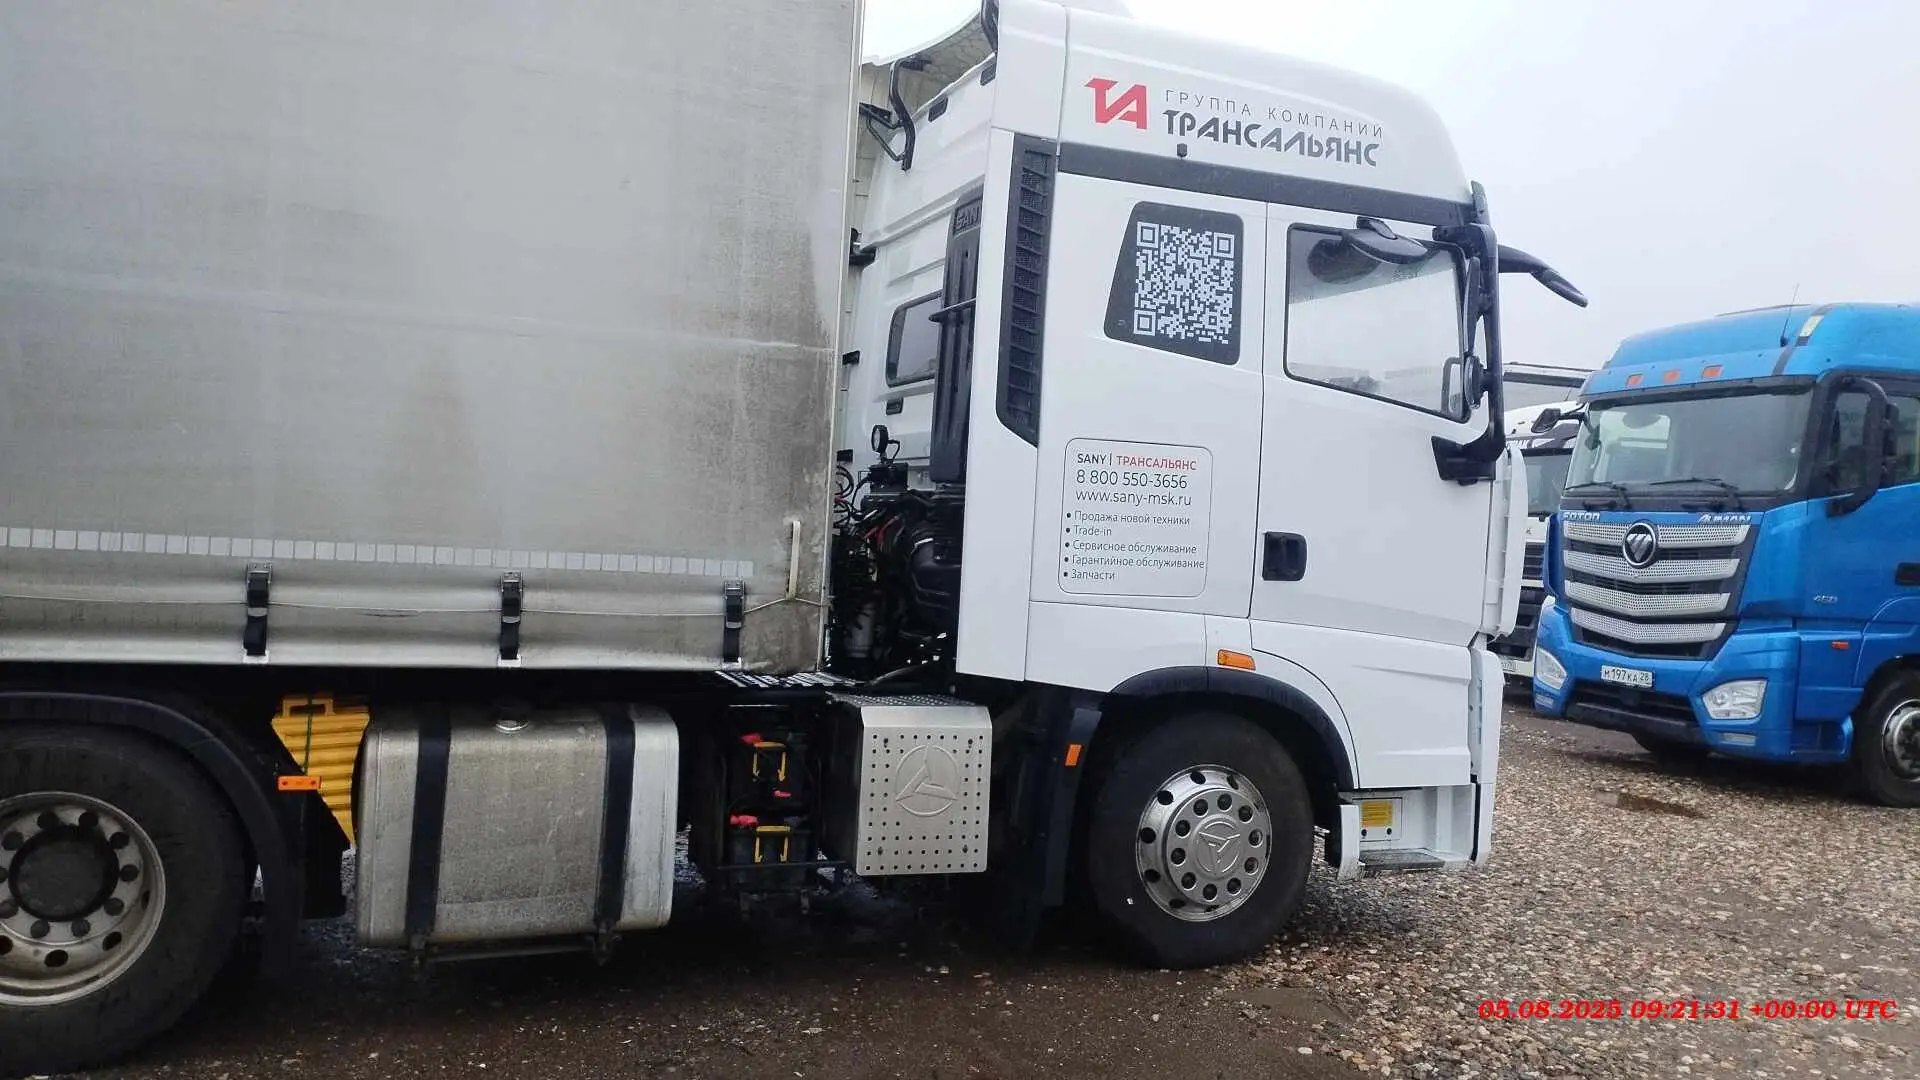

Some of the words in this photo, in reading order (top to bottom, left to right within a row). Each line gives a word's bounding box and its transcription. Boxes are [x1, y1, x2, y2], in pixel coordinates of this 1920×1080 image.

[1165, 89, 1251, 116] ГРУППА
[1267, 107, 1383, 139] КОМПАНИИ
[1162, 109, 1380, 167] ТРАНСАЛЬЯНС
[1077, 453, 1107, 465] SANY
[1116, 455, 1197, 470] ТРАНСАЛЬЯНС
[1076, 469, 1086, 484] 8
[1089, 470, 1119, 485] 800
[1122, 472, 1188, 489] 550-3656
[1076, 490, 1192, 507] www.sany-msk.ru
[1074, 510, 1118, 523] Продажа
[1120, 514, 1150, 524] новой
[1153, 515, 1190, 525] техники
[1073, 525, 1112, 536] Trade-in
[1072, 540, 1126, 553] Сервисное
[1128, 542, 1197, 555] обслуживание
[1071, 555, 1134, 567] Гарантийное
[1136, 557, 1205, 569] обслуживание
[1071, 569, 1115, 580] Запчасти
